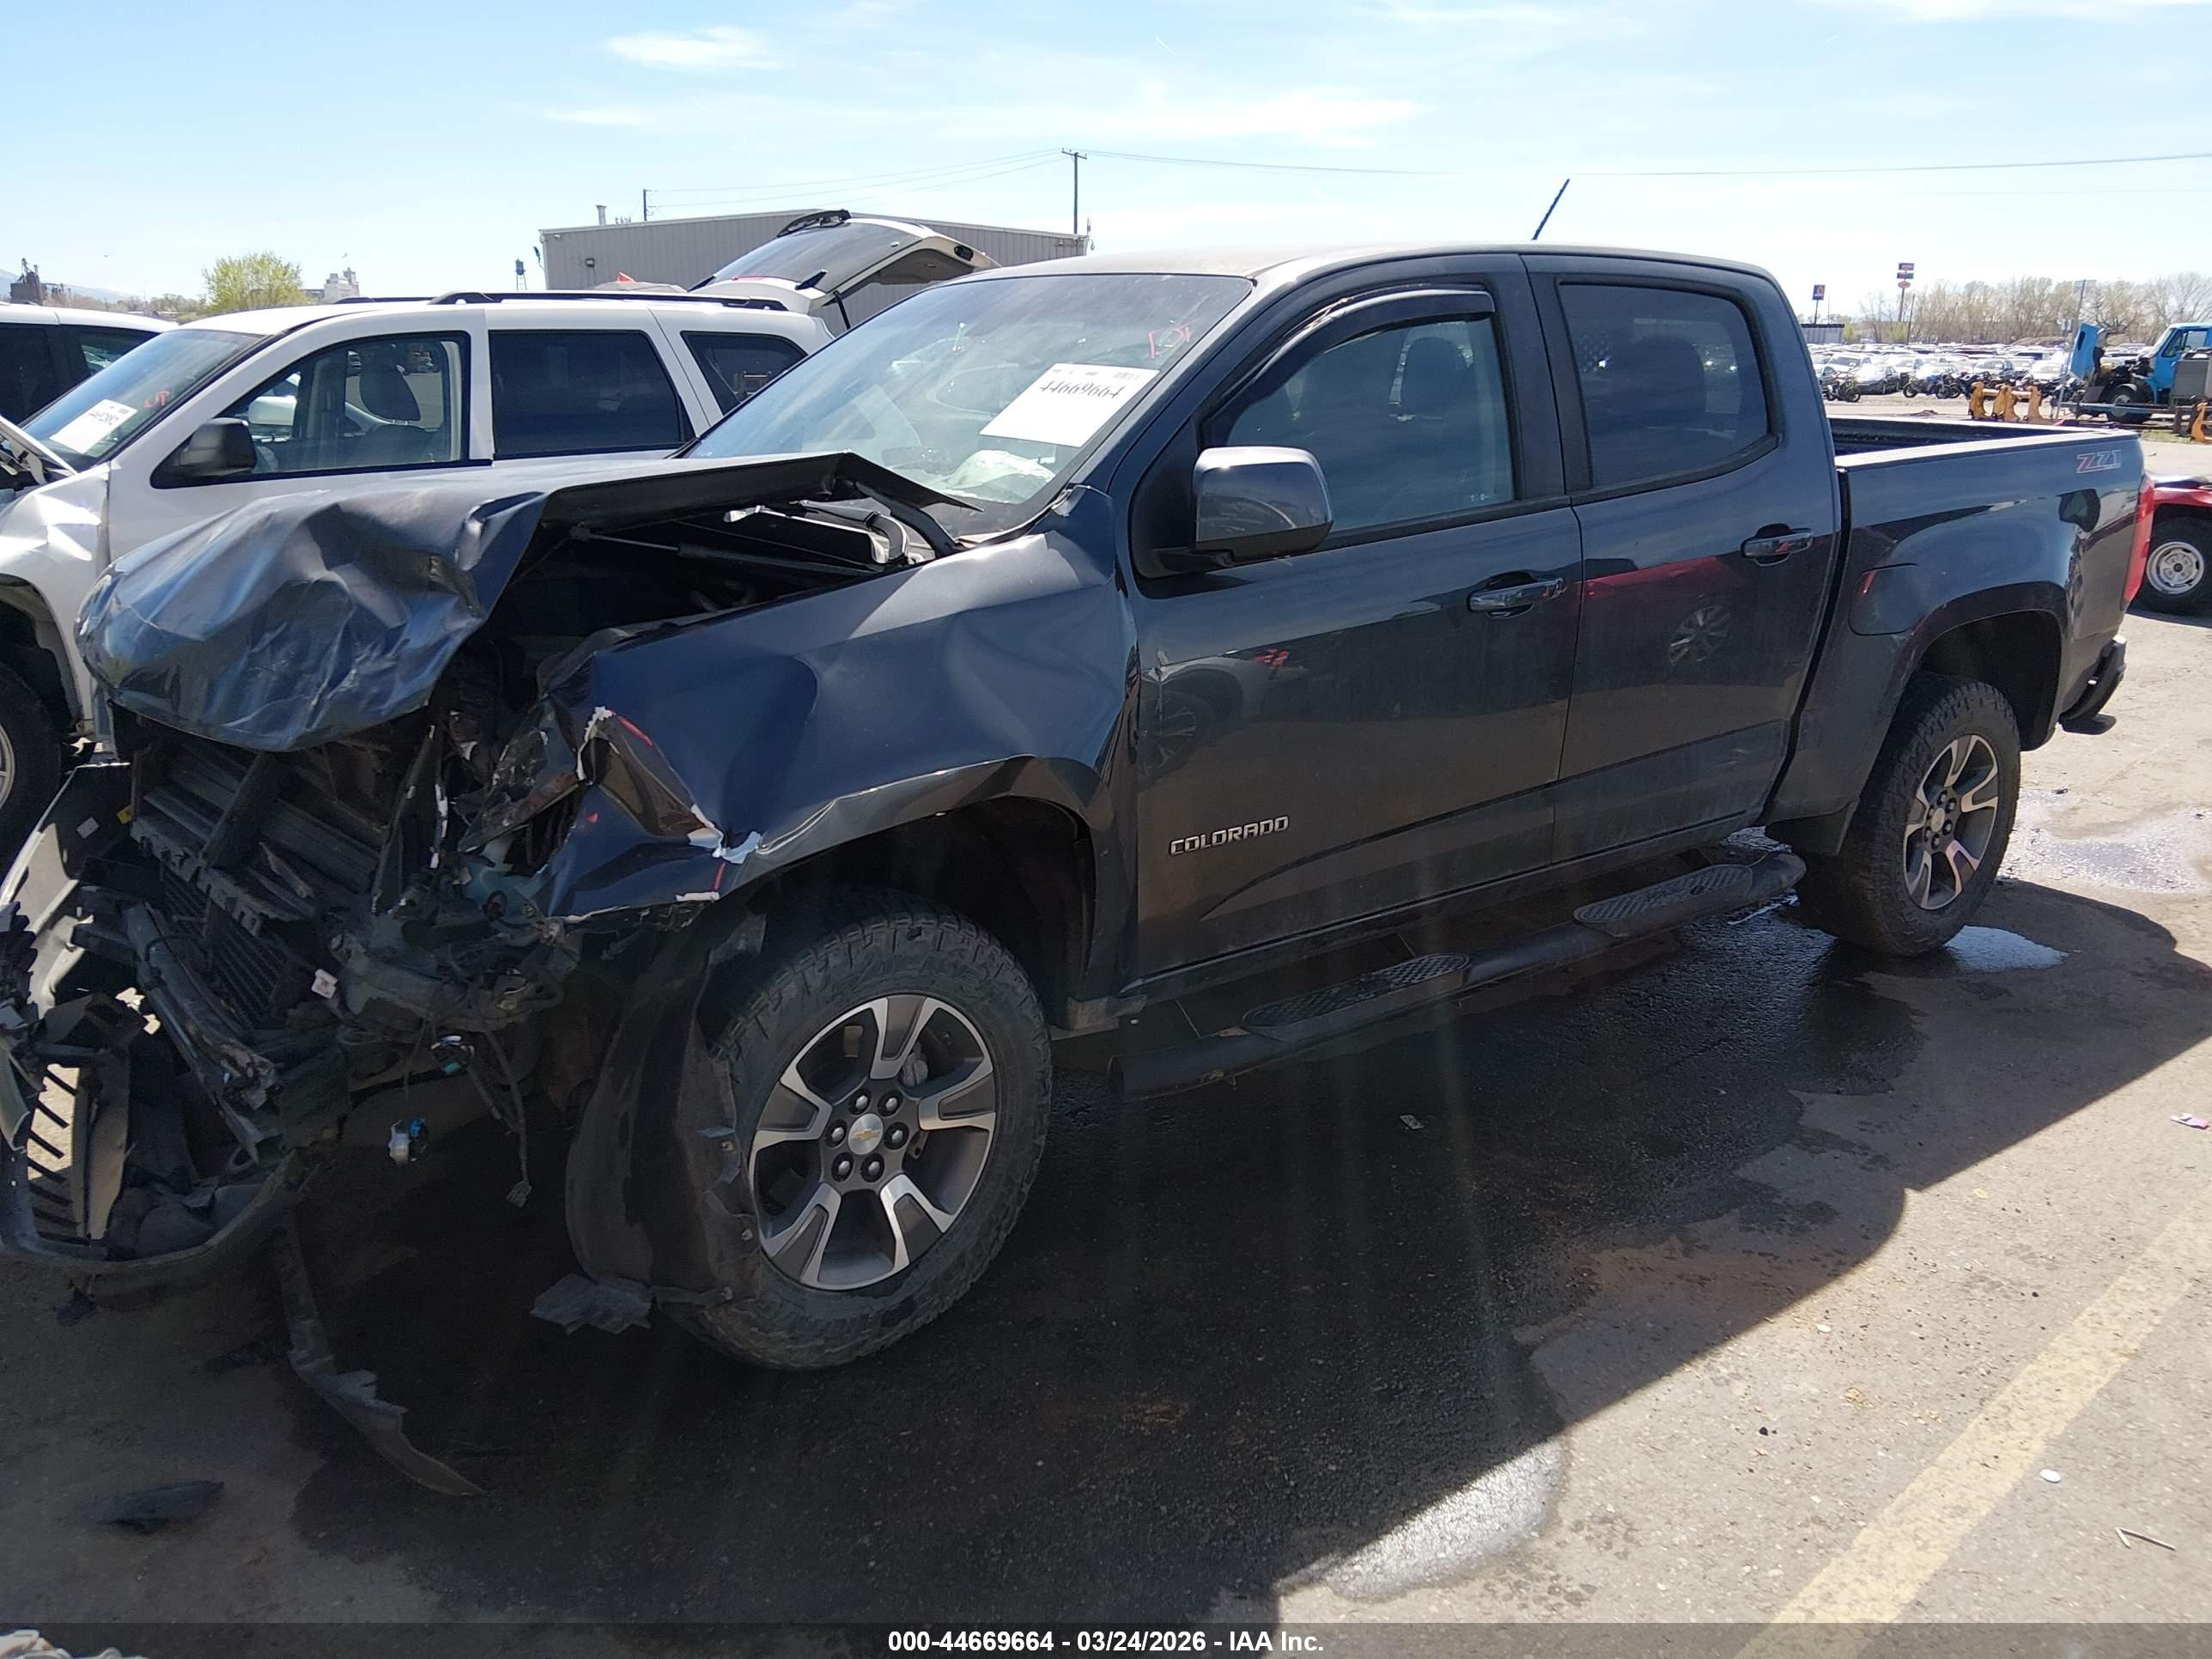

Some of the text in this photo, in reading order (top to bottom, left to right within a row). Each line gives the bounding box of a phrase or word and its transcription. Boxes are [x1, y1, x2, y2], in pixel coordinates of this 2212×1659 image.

[1039, 380, 1126, 398] 44669664
[2076, 449, 2122, 474] Z71
[1170, 816, 1290, 855] COLORADO
